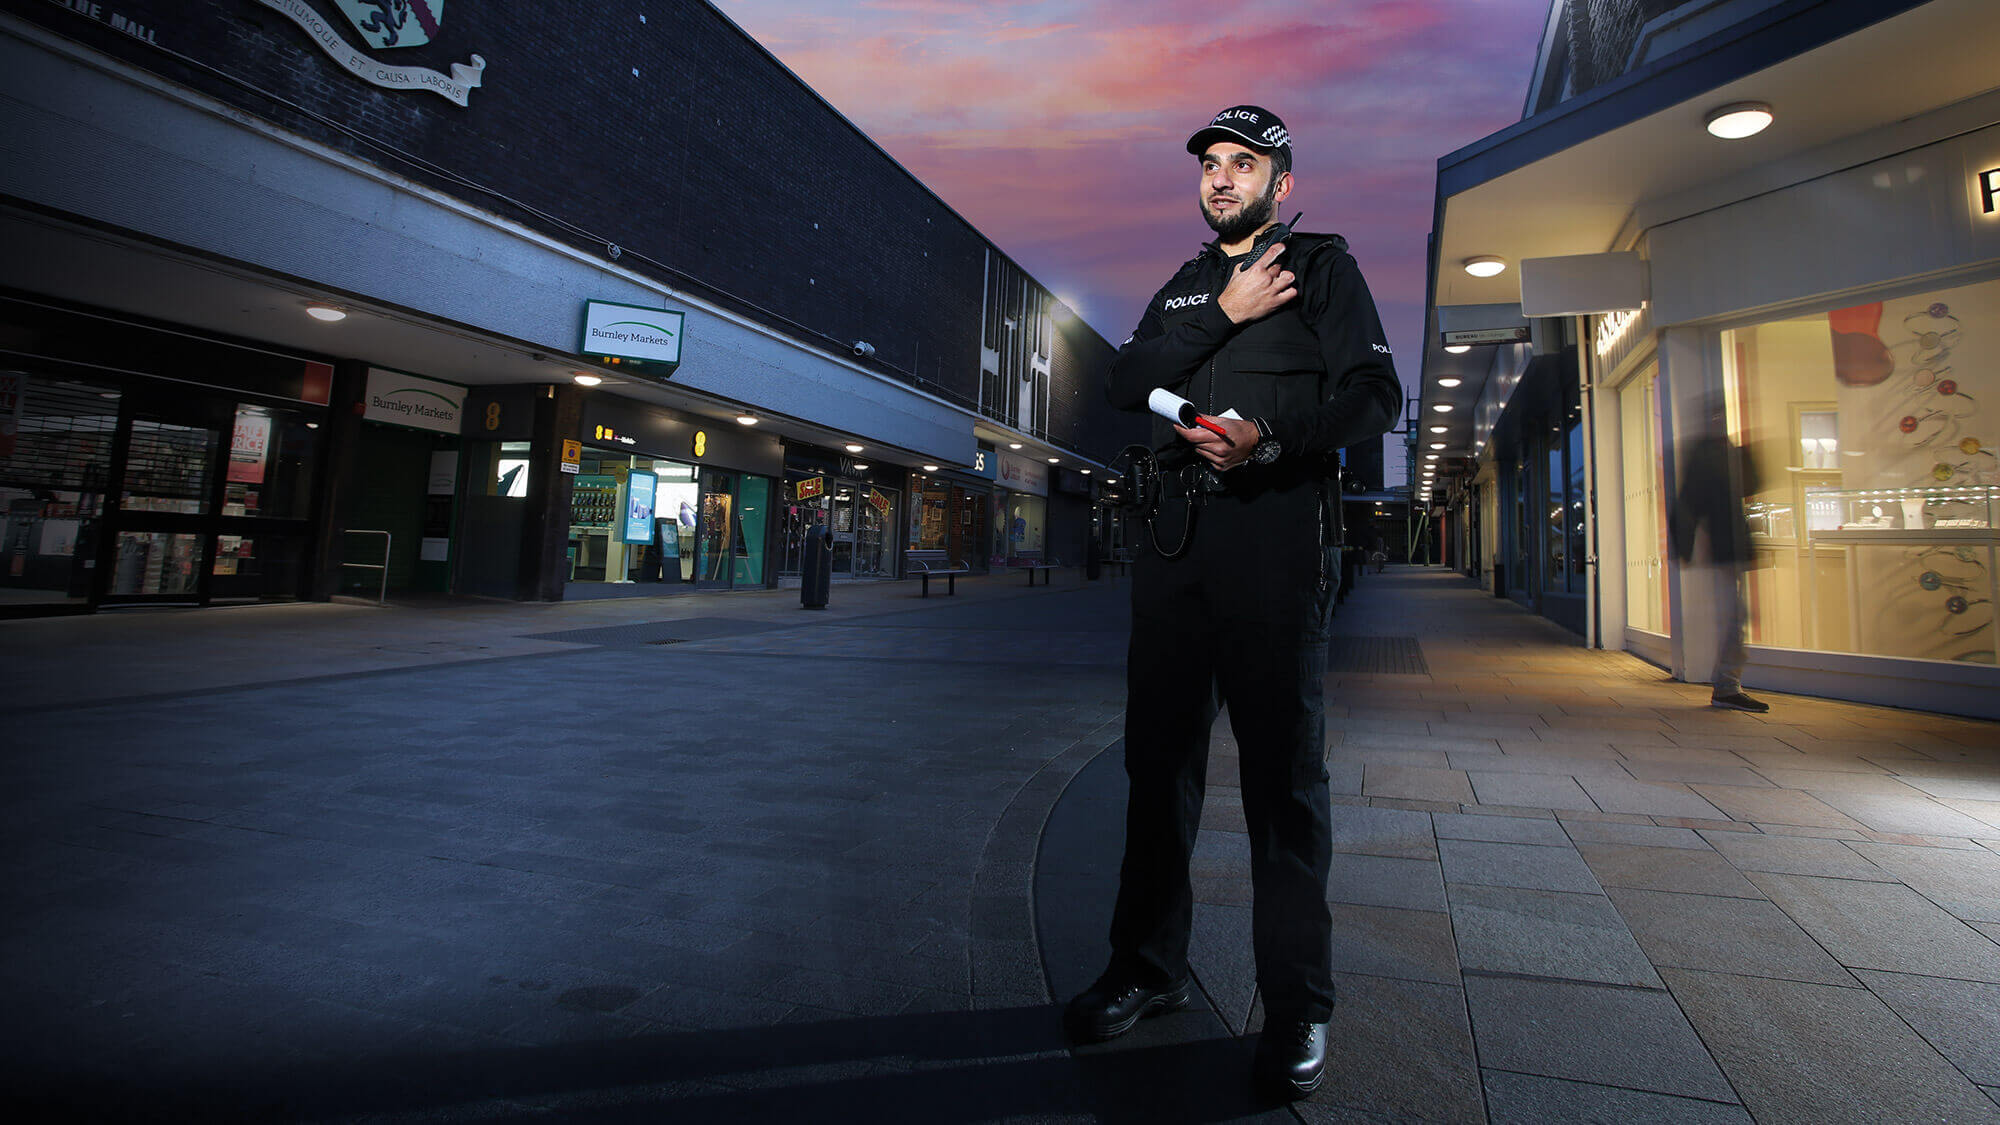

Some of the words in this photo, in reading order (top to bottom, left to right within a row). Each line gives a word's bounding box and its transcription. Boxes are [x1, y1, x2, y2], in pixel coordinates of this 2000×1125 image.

[111, 12, 159, 46] MALL
[275, 0, 339, 50] TIUMQUE
[349, 56, 366, 71] ET
[376, 69, 410, 84] CAUSA
[420, 73, 462, 99] LABORIS
[1164, 292, 1210, 311] POLICE
[592, 327, 629, 342] Burnley
[630, 333, 668, 346] Markets
[373, 396, 413, 415] Burnley
[414, 404, 454, 421] Markets
[798, 477, 822, 499] SALE
[870, 490, 889, 512] SALE
